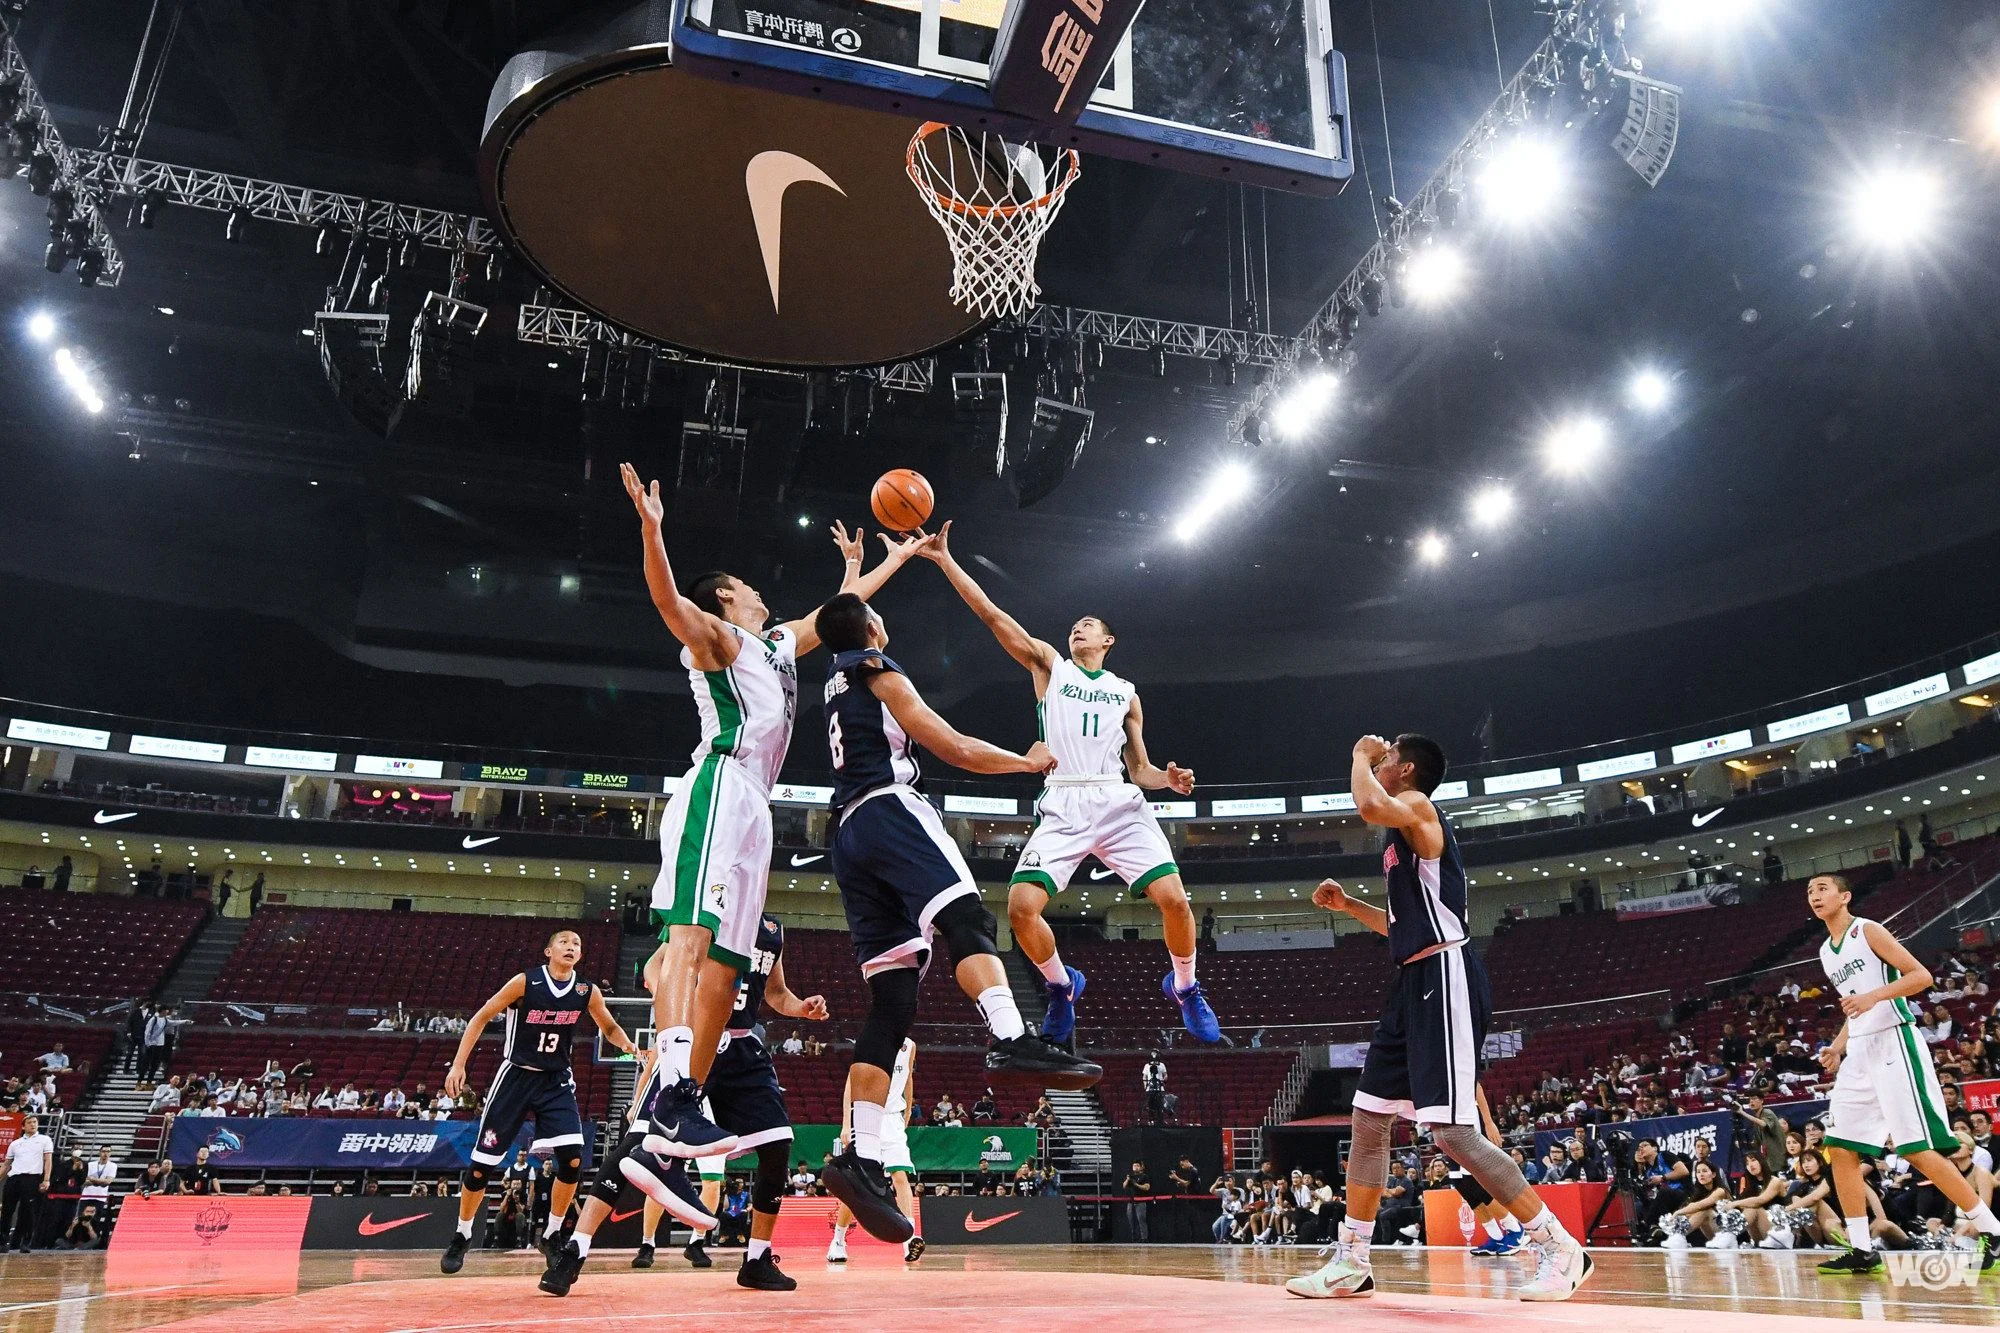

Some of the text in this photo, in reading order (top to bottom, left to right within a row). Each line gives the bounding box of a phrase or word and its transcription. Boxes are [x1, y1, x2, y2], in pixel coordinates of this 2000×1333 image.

[1059, 683, 1125, 706] 松山高中
[1082, 711, 1099, 738] 11
[828, 710, 845, 770] 8
[481, 765, 528, 777] BRAVO
[583, 773, 629, 784] BRAVO
[537, 1032, 560, 1053] 13
